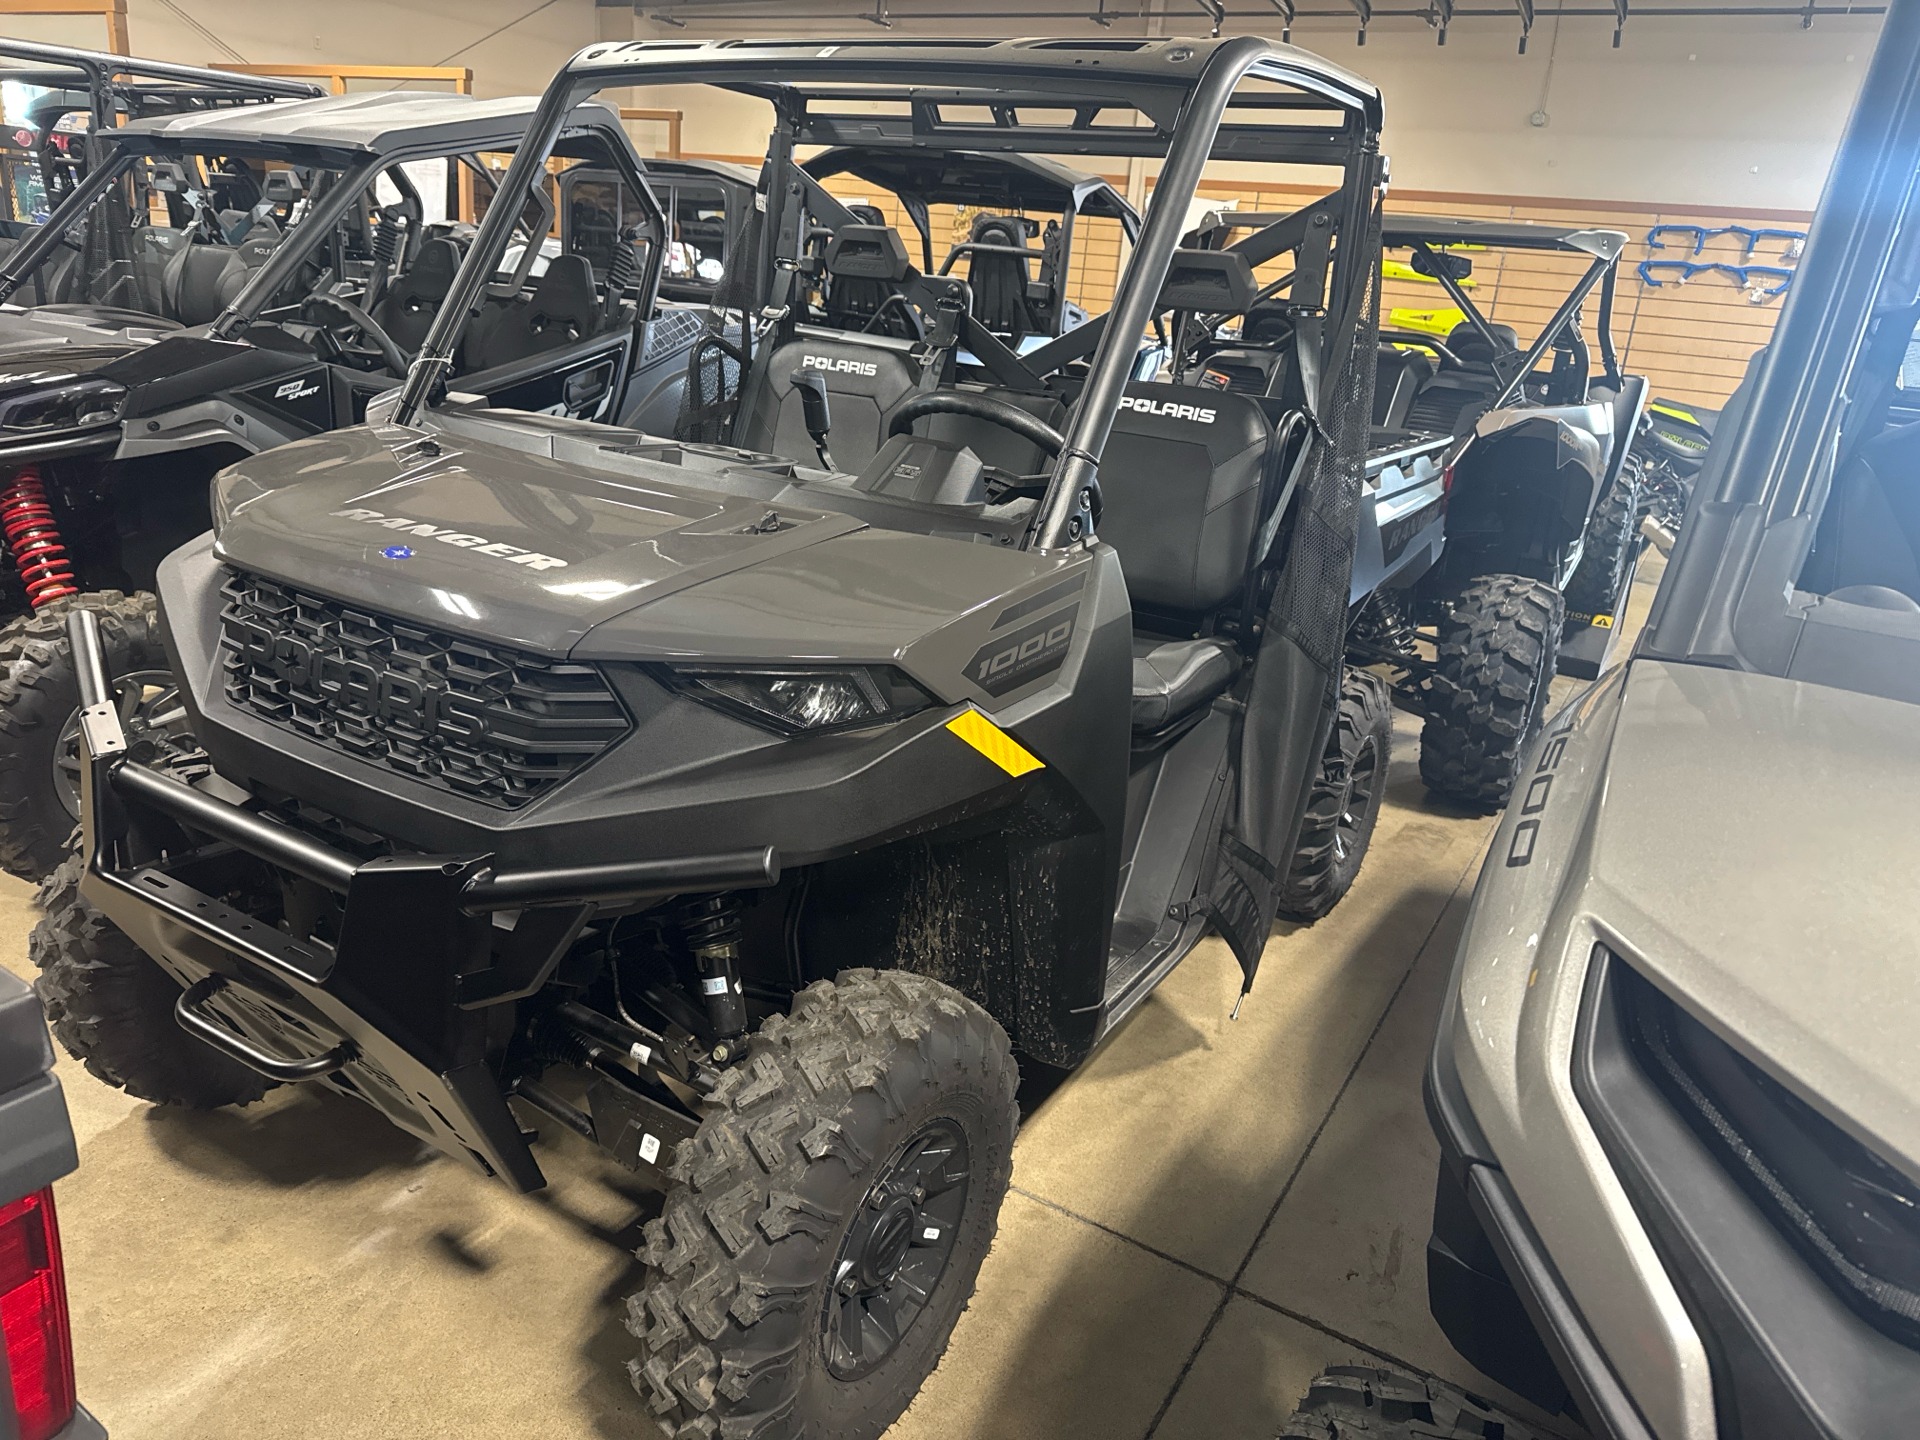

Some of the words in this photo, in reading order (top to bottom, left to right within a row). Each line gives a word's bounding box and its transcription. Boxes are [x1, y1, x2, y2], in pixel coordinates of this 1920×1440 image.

[144, 234, 169, 244] POLARIS
[802, 355, 878, 377] POLARIS
[287, 385, 320, 401] SPORT
[1117, 396, 1217, 424] POLARIS
[328, 508, 568, 571] RANGER
[978, 620, 1071, 681] 1000
[242, 620, 489, 746] POLARIS
[1505, 722, 1575, 869] 1500
